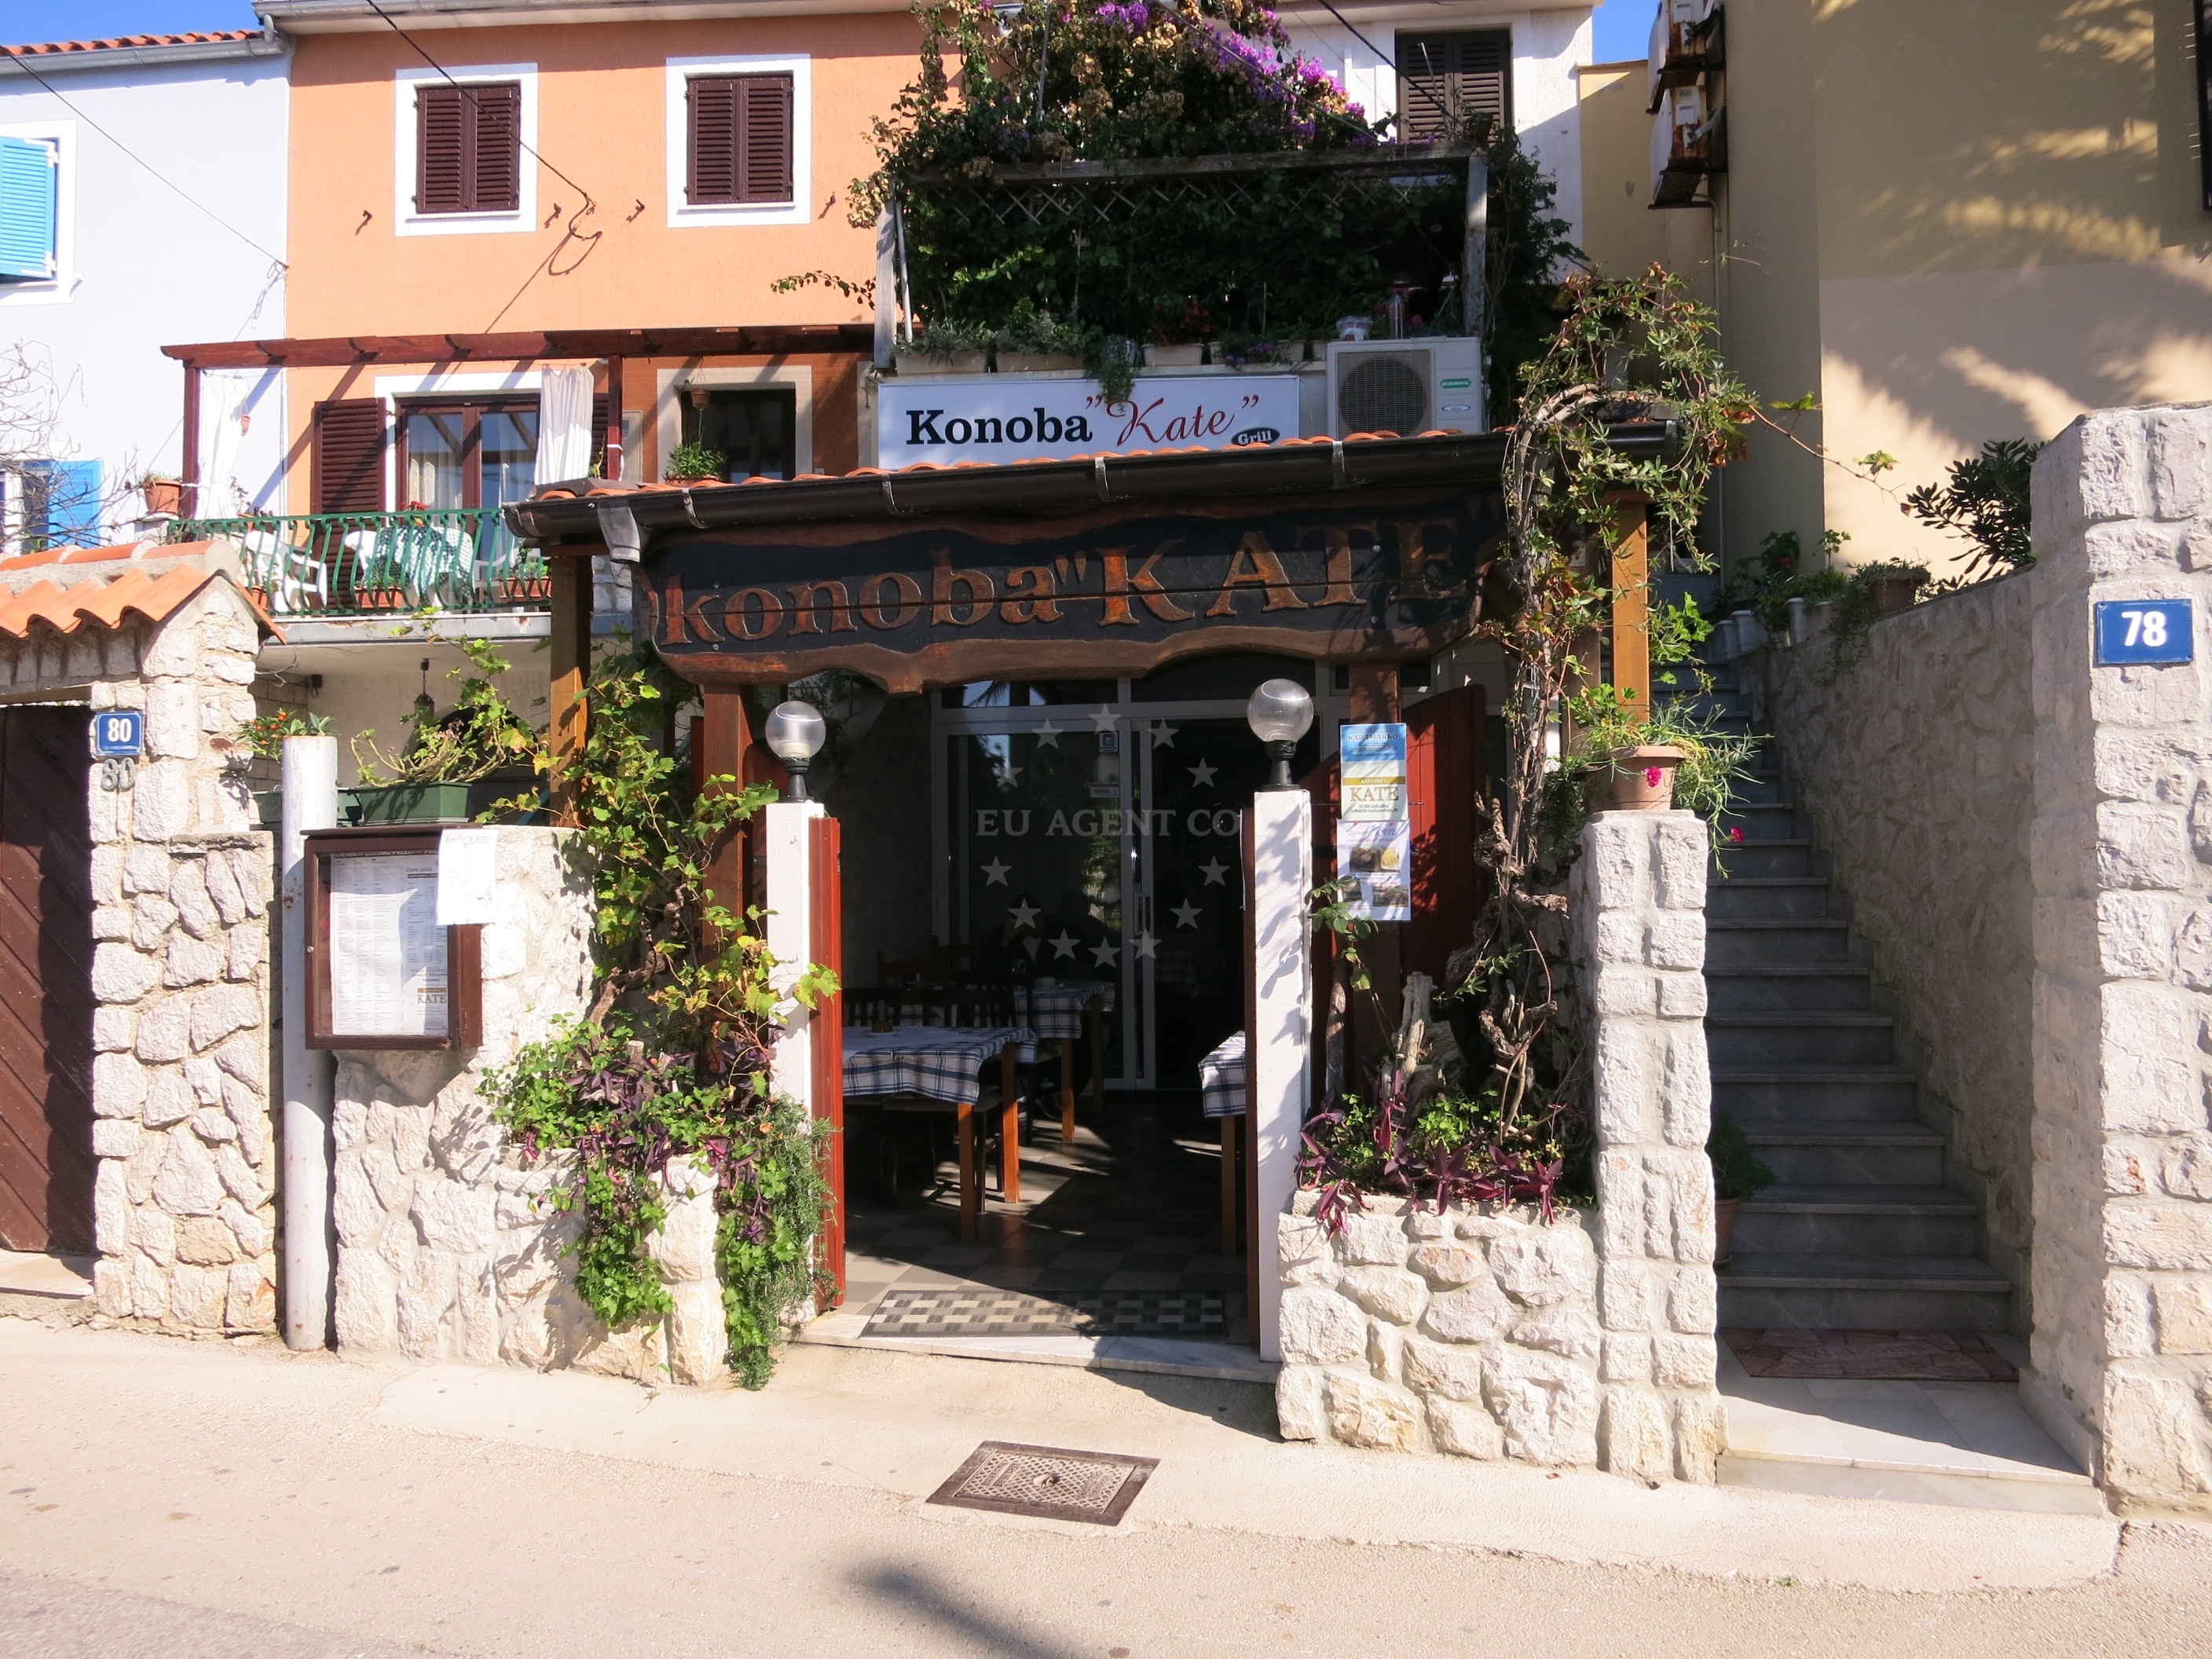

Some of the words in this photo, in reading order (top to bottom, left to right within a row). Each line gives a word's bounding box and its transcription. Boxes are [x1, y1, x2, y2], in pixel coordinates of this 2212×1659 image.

[906, 407, 1093, 445] Konoba
[1237, 430, 1273, 445] Grill
[2121, 610, 2167, 647] 78
[108, 717, 132, 743] 80
[101, 757, 135, 792] 80
[1349, 786, 1399, 802] KATE
[417, 994, 448, 1004] KATE
